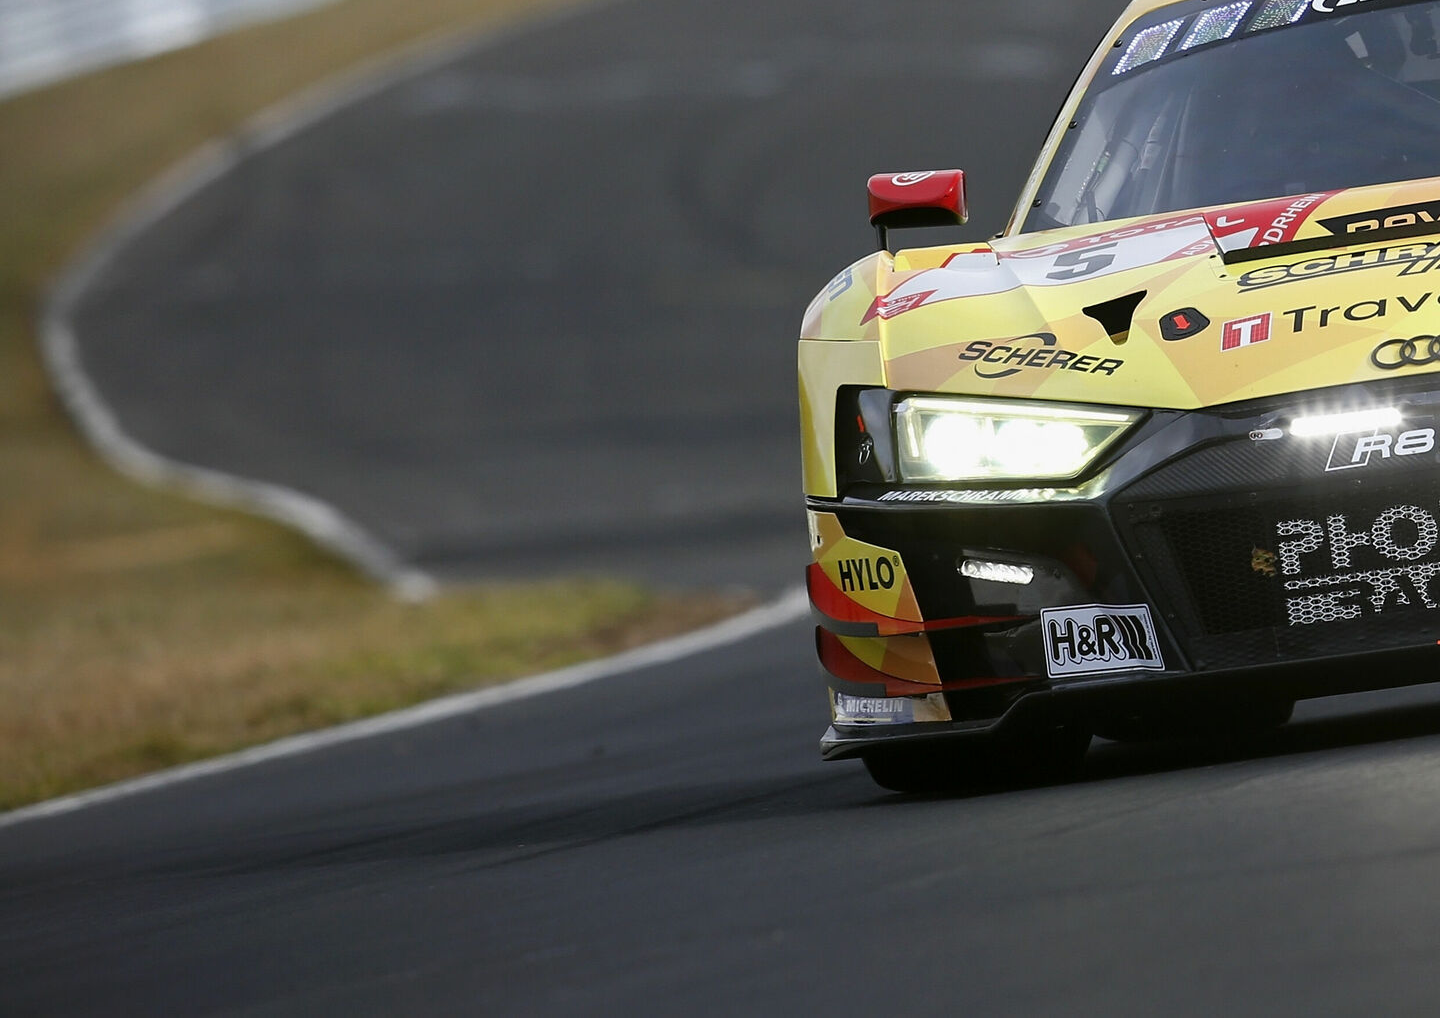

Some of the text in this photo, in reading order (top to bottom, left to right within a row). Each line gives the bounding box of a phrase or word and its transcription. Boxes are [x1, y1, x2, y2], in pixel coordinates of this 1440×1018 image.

[1045, 242, 1119, 281] 5
[958, 339, 1124, 377] SCHERER
[1351, 428, 1435, 464] R8
[838, 556, 895, 593] HYLO
[1049, 615, 1124, 666] H&R
[846, 698, 904, 714] MICHELIN
